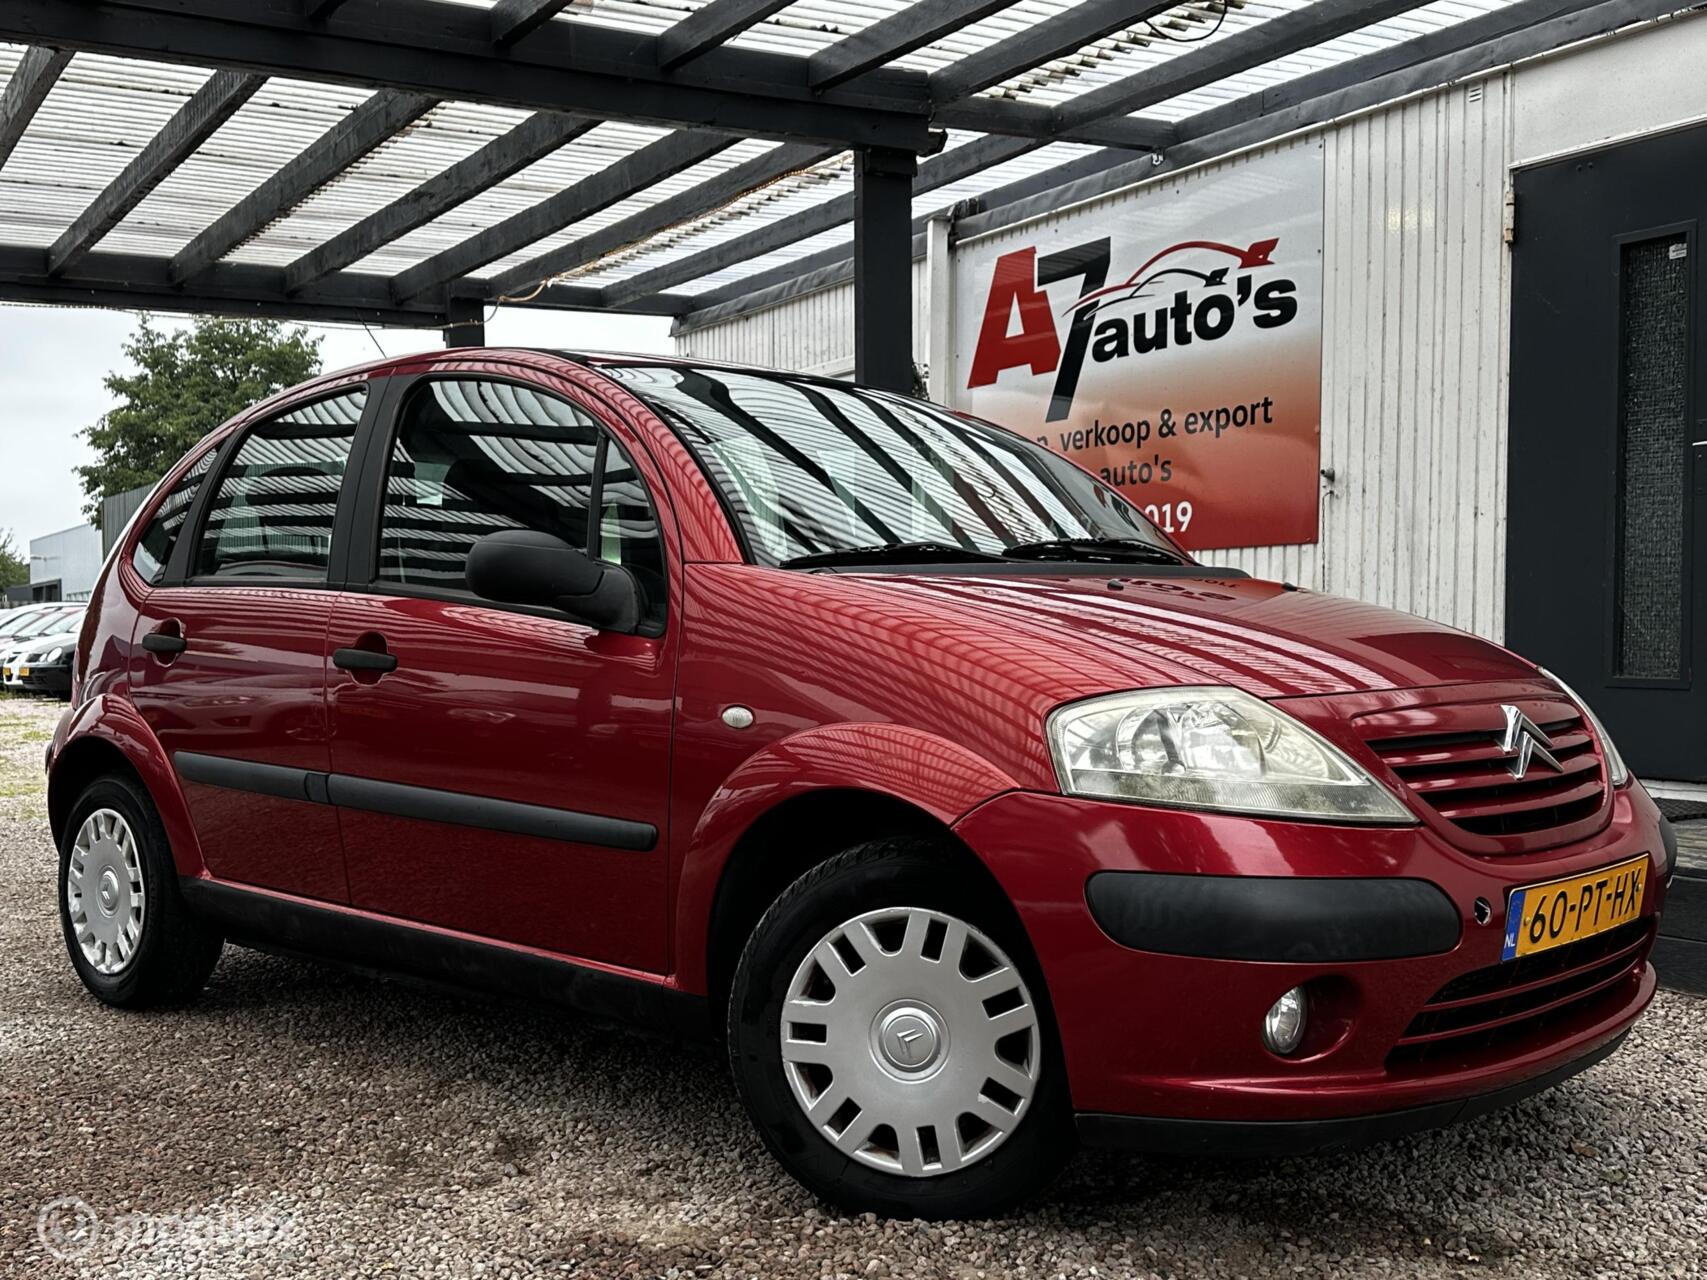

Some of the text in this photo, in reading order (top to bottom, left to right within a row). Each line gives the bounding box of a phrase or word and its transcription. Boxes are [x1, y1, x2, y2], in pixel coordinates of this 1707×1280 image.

[1060, 419, 1151, 451] verkoop
[1158, 408, 1177, 439] &
[1184, 396, 1273, 437] export
[1100, 454, 1172, 487] auto's
[1504, 868, 1642, 949] NL 60-PT-HX
